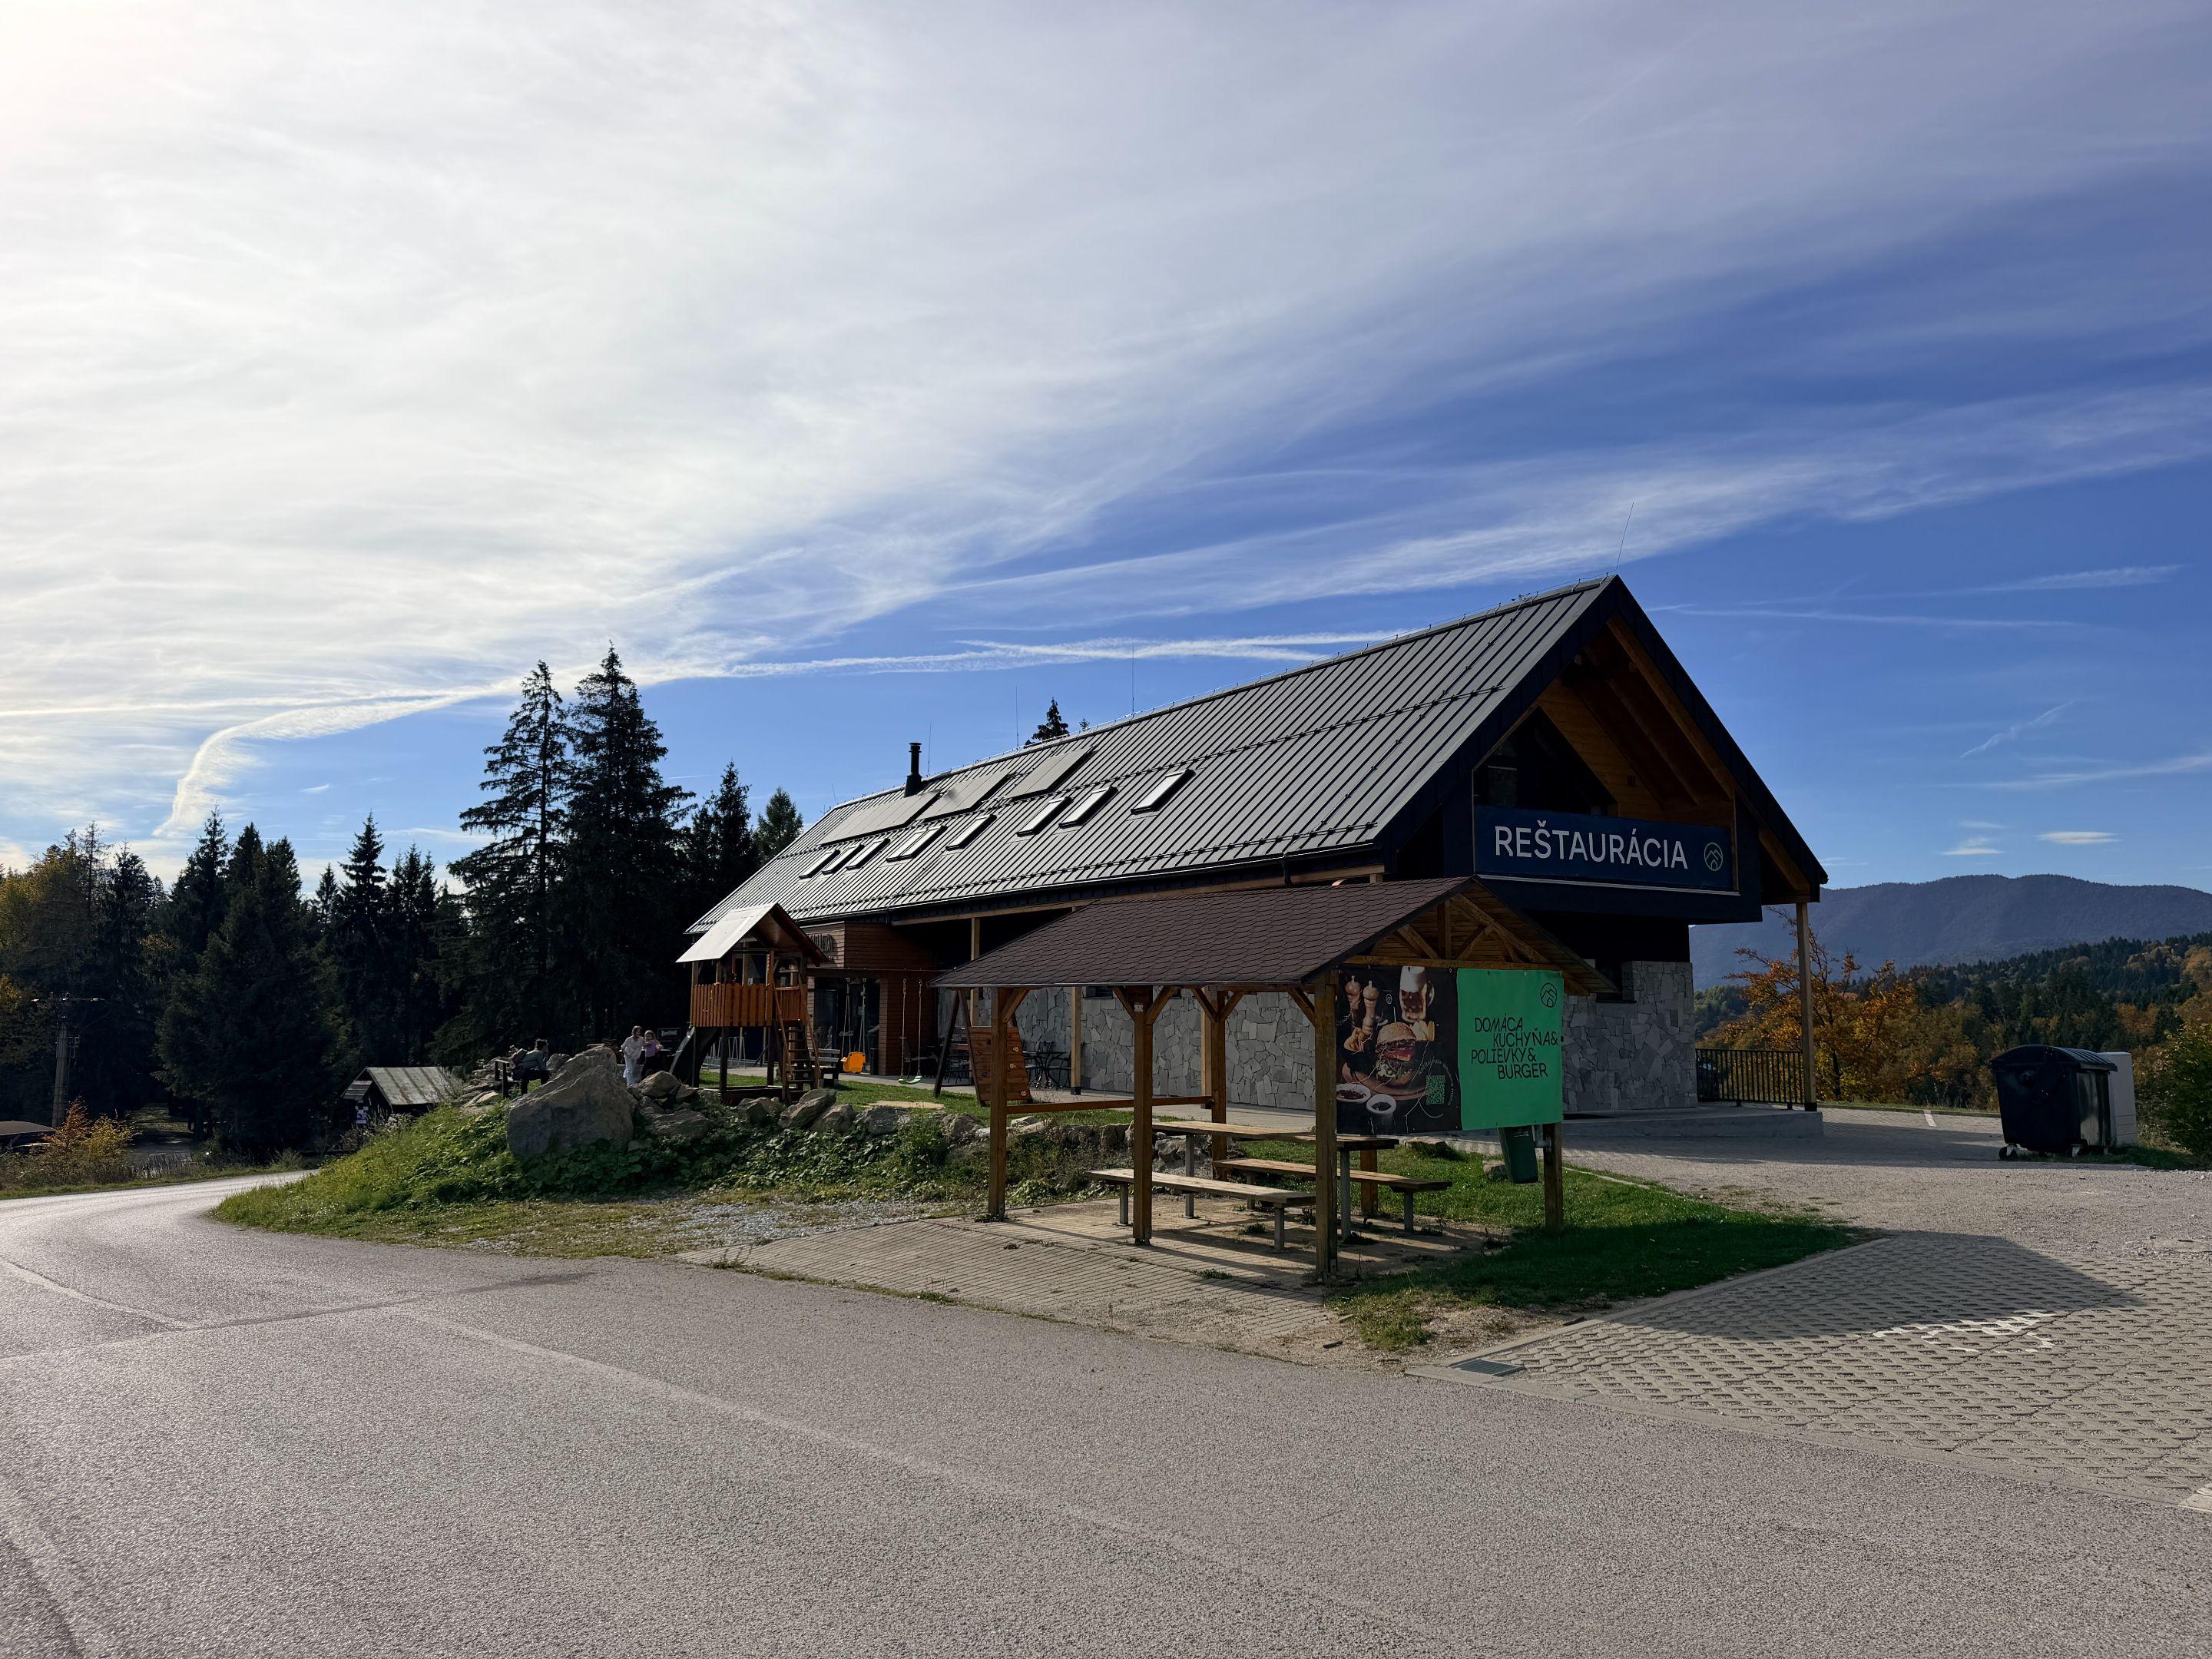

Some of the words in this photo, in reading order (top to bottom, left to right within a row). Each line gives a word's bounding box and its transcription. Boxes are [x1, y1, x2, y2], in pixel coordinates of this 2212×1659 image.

[1495, 820, 1688, 869] REŠTAURÁCIA
[1475, 1012, 1524, 1032] DOMÁCA
[1498, 1062, 1548, 1080] BURGER
